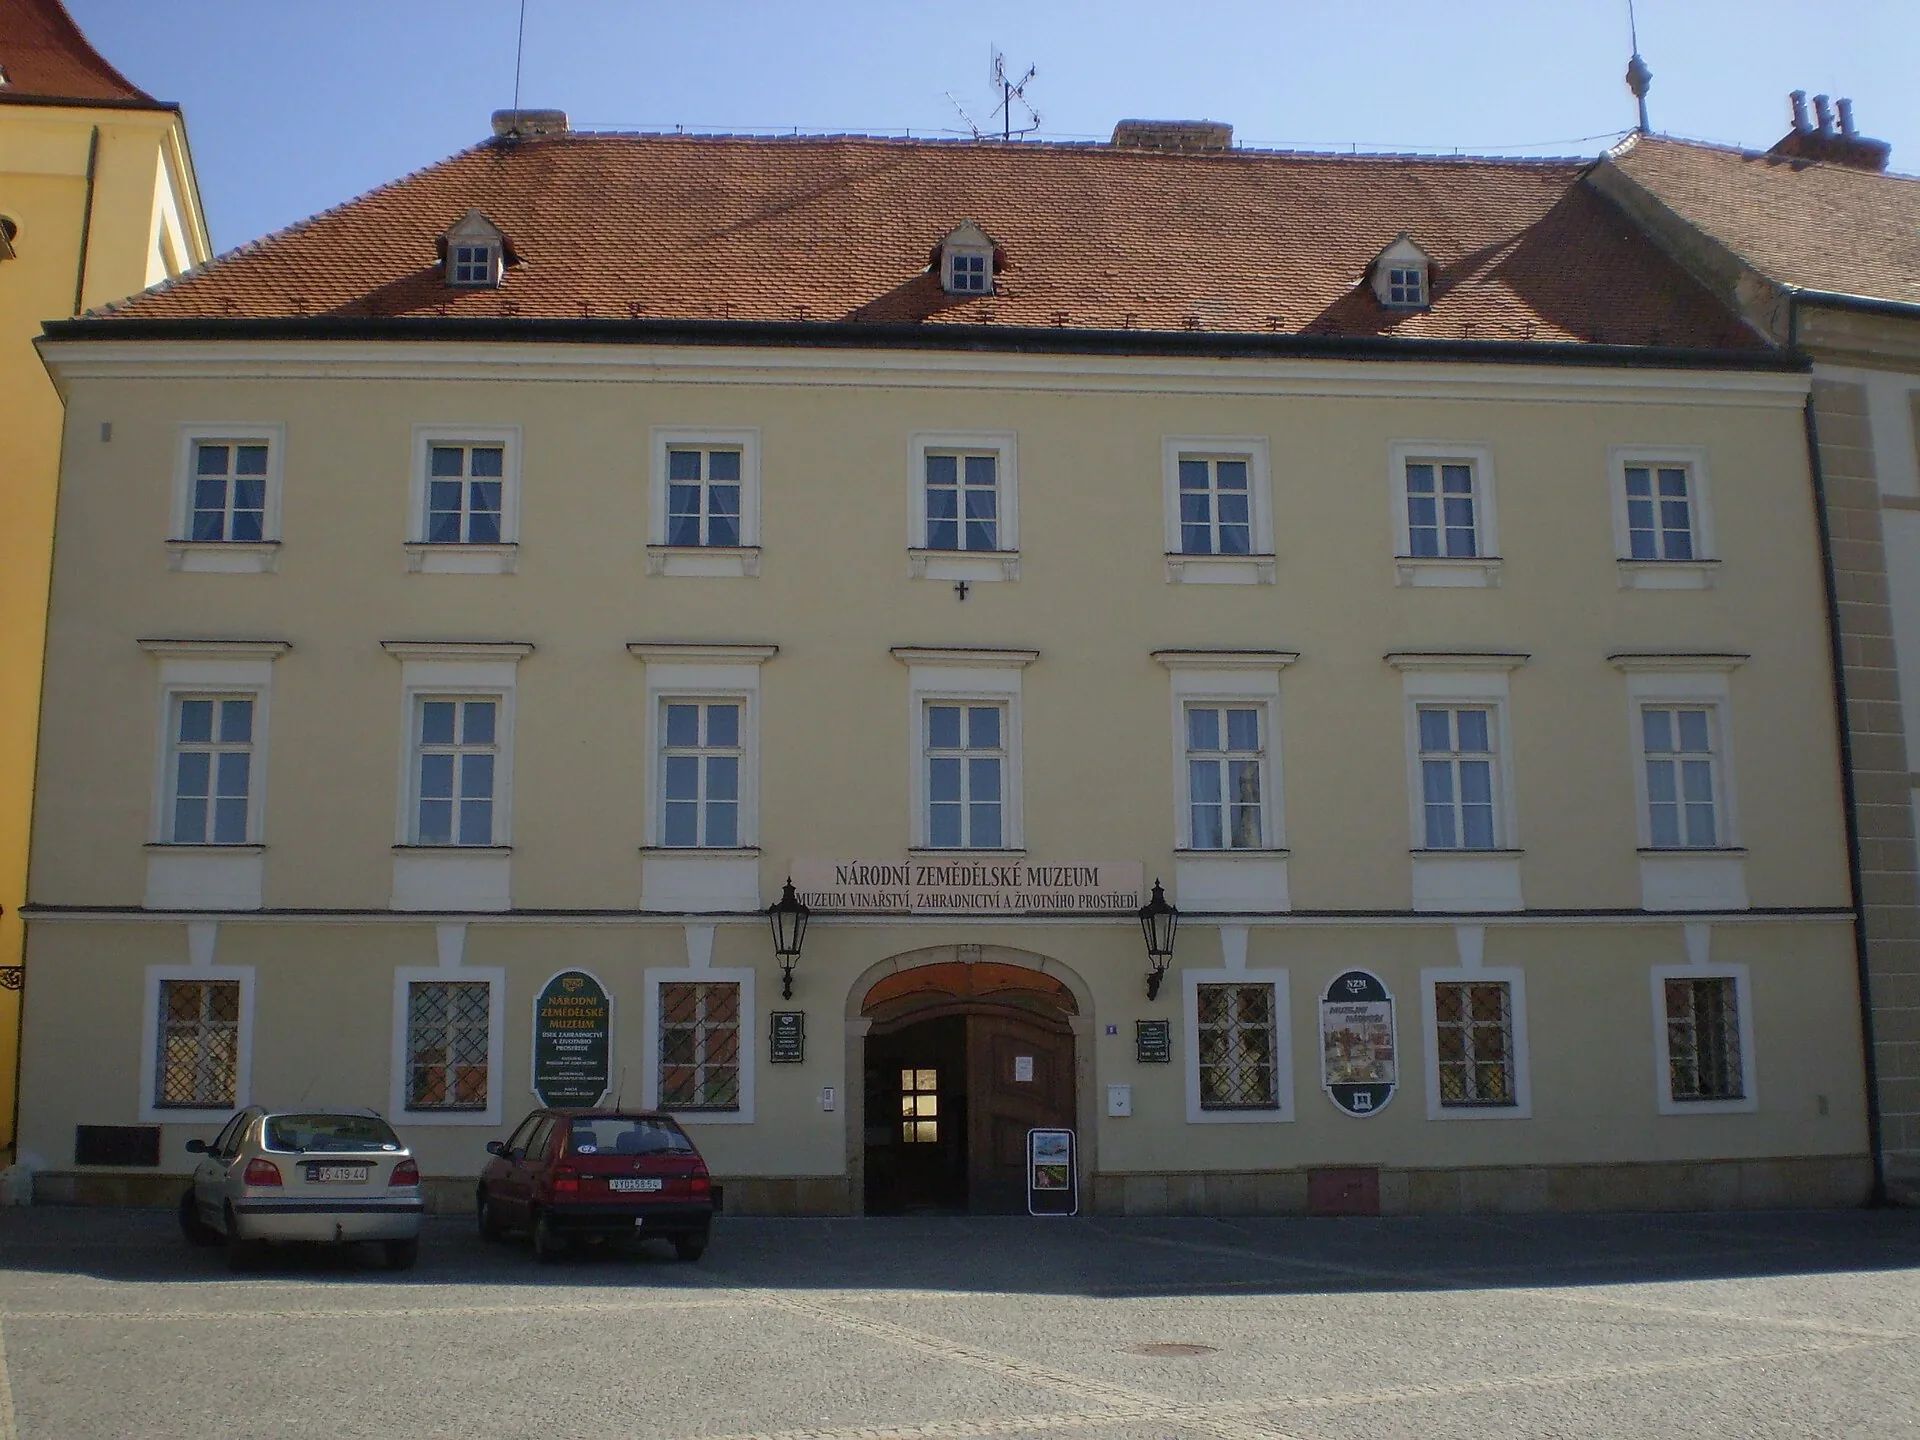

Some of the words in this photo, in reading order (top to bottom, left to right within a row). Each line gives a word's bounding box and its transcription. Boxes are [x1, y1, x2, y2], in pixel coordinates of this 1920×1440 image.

[836, 861, 911, 886] NÁRODNÍ
[917, 862, 1022, 887] ZEMĚDĚLSKÉ
[1027, 867, 1100, 887] MUZEUM
[796, 892, 846, 908] MUZEUM
[850, 890, 913, 909] VINAŘSTVÍ,
[917, 891, 1000, 908] ZAHRADNICTVÍ
[1003, 895, 1011, 908] A
[1014, 891, 1075, 909] ŽIVOTNÍHO
[1078, 891, 1138, 909] PROSTŘEDÍ
